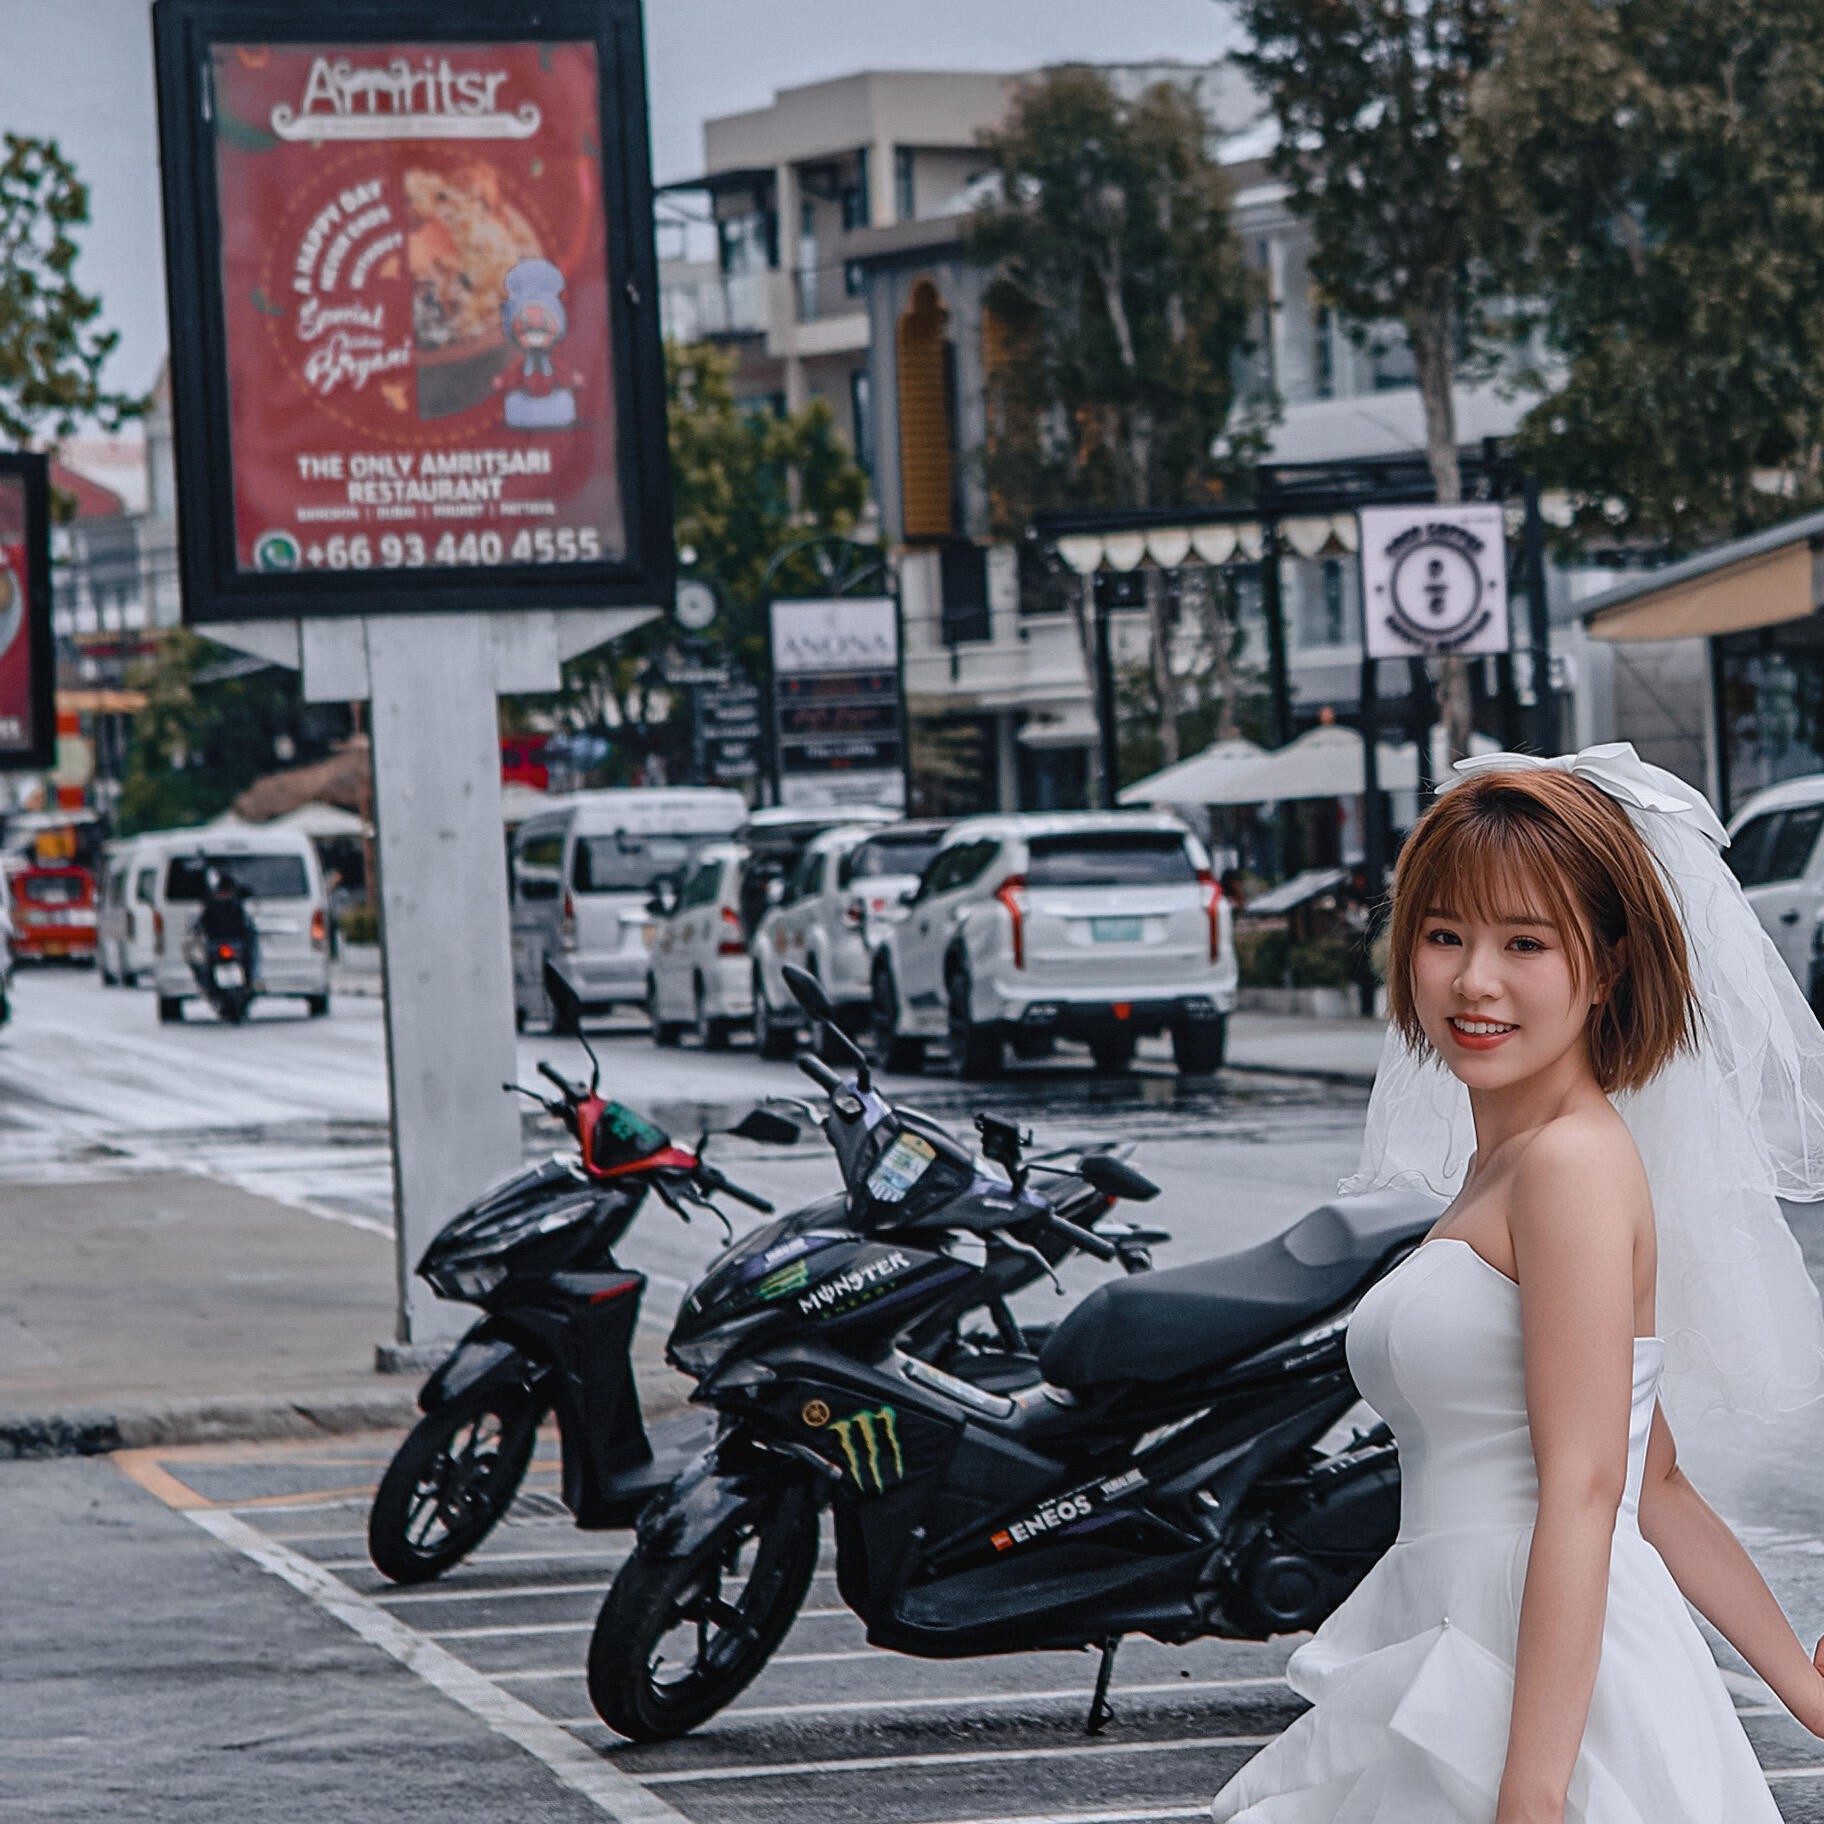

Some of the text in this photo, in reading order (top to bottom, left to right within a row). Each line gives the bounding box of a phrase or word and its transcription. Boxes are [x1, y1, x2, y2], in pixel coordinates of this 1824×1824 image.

[302, 55, 508, 115] Amritsr
[339, 178, 382, 213] DAY
[298, 448, 551, 480] THE ONLY AMRITSARI
[347, 477, 503, 504] RESTAURANT
[306, 527, 600, 570] +66 93 440 4555
[798, 1250, 911, 1315] MONSTER
[1008, 1494, 1092, 1543] ENEOS
